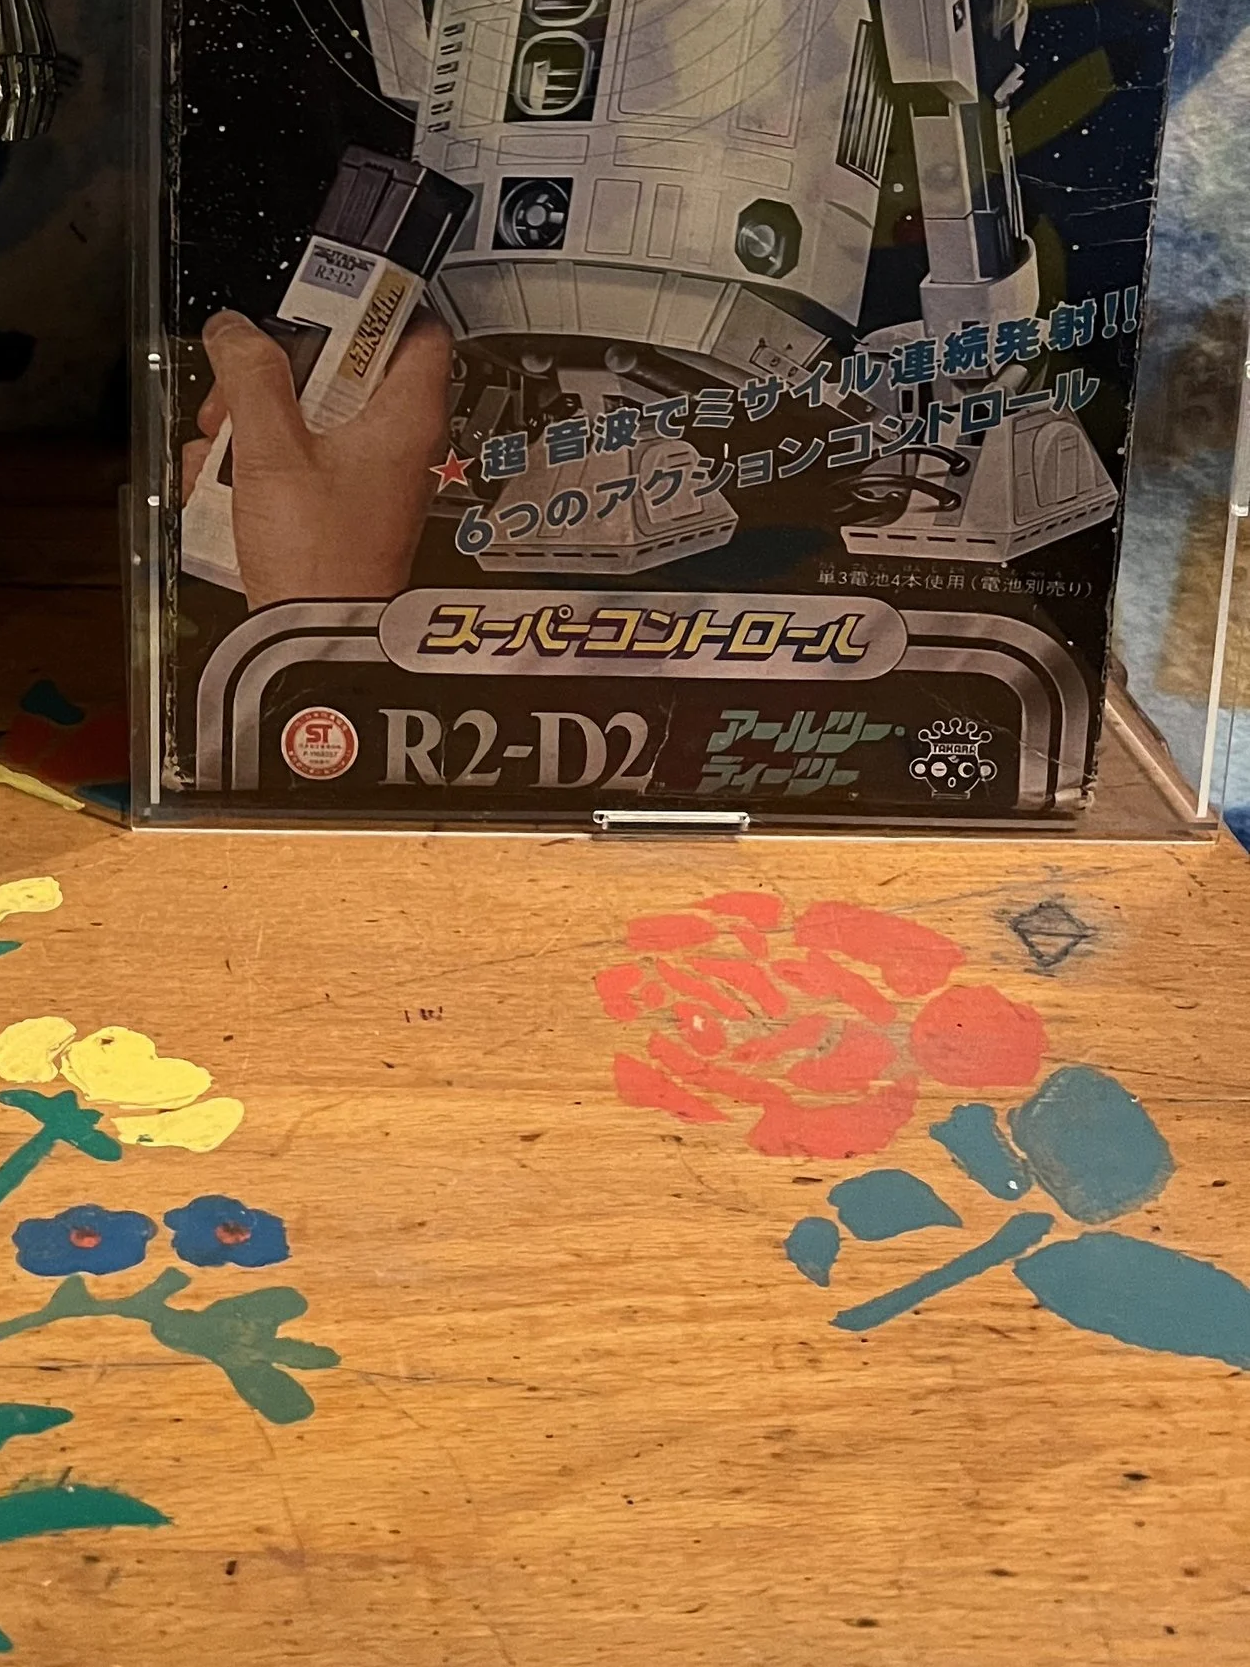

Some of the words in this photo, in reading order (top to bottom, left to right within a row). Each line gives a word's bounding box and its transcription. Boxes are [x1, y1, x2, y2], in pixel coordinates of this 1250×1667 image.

[315, 265, 356, 287] R2-D2
[454, 368, 1100, 555] 6つのアクションコントロール
[417, 604, 871, 663] スーパーコントロール
[306, 724, 333, 743] ST
[378, 709, 652, 789] R2-D2
[933, 744, 977, 754] TAKARA
